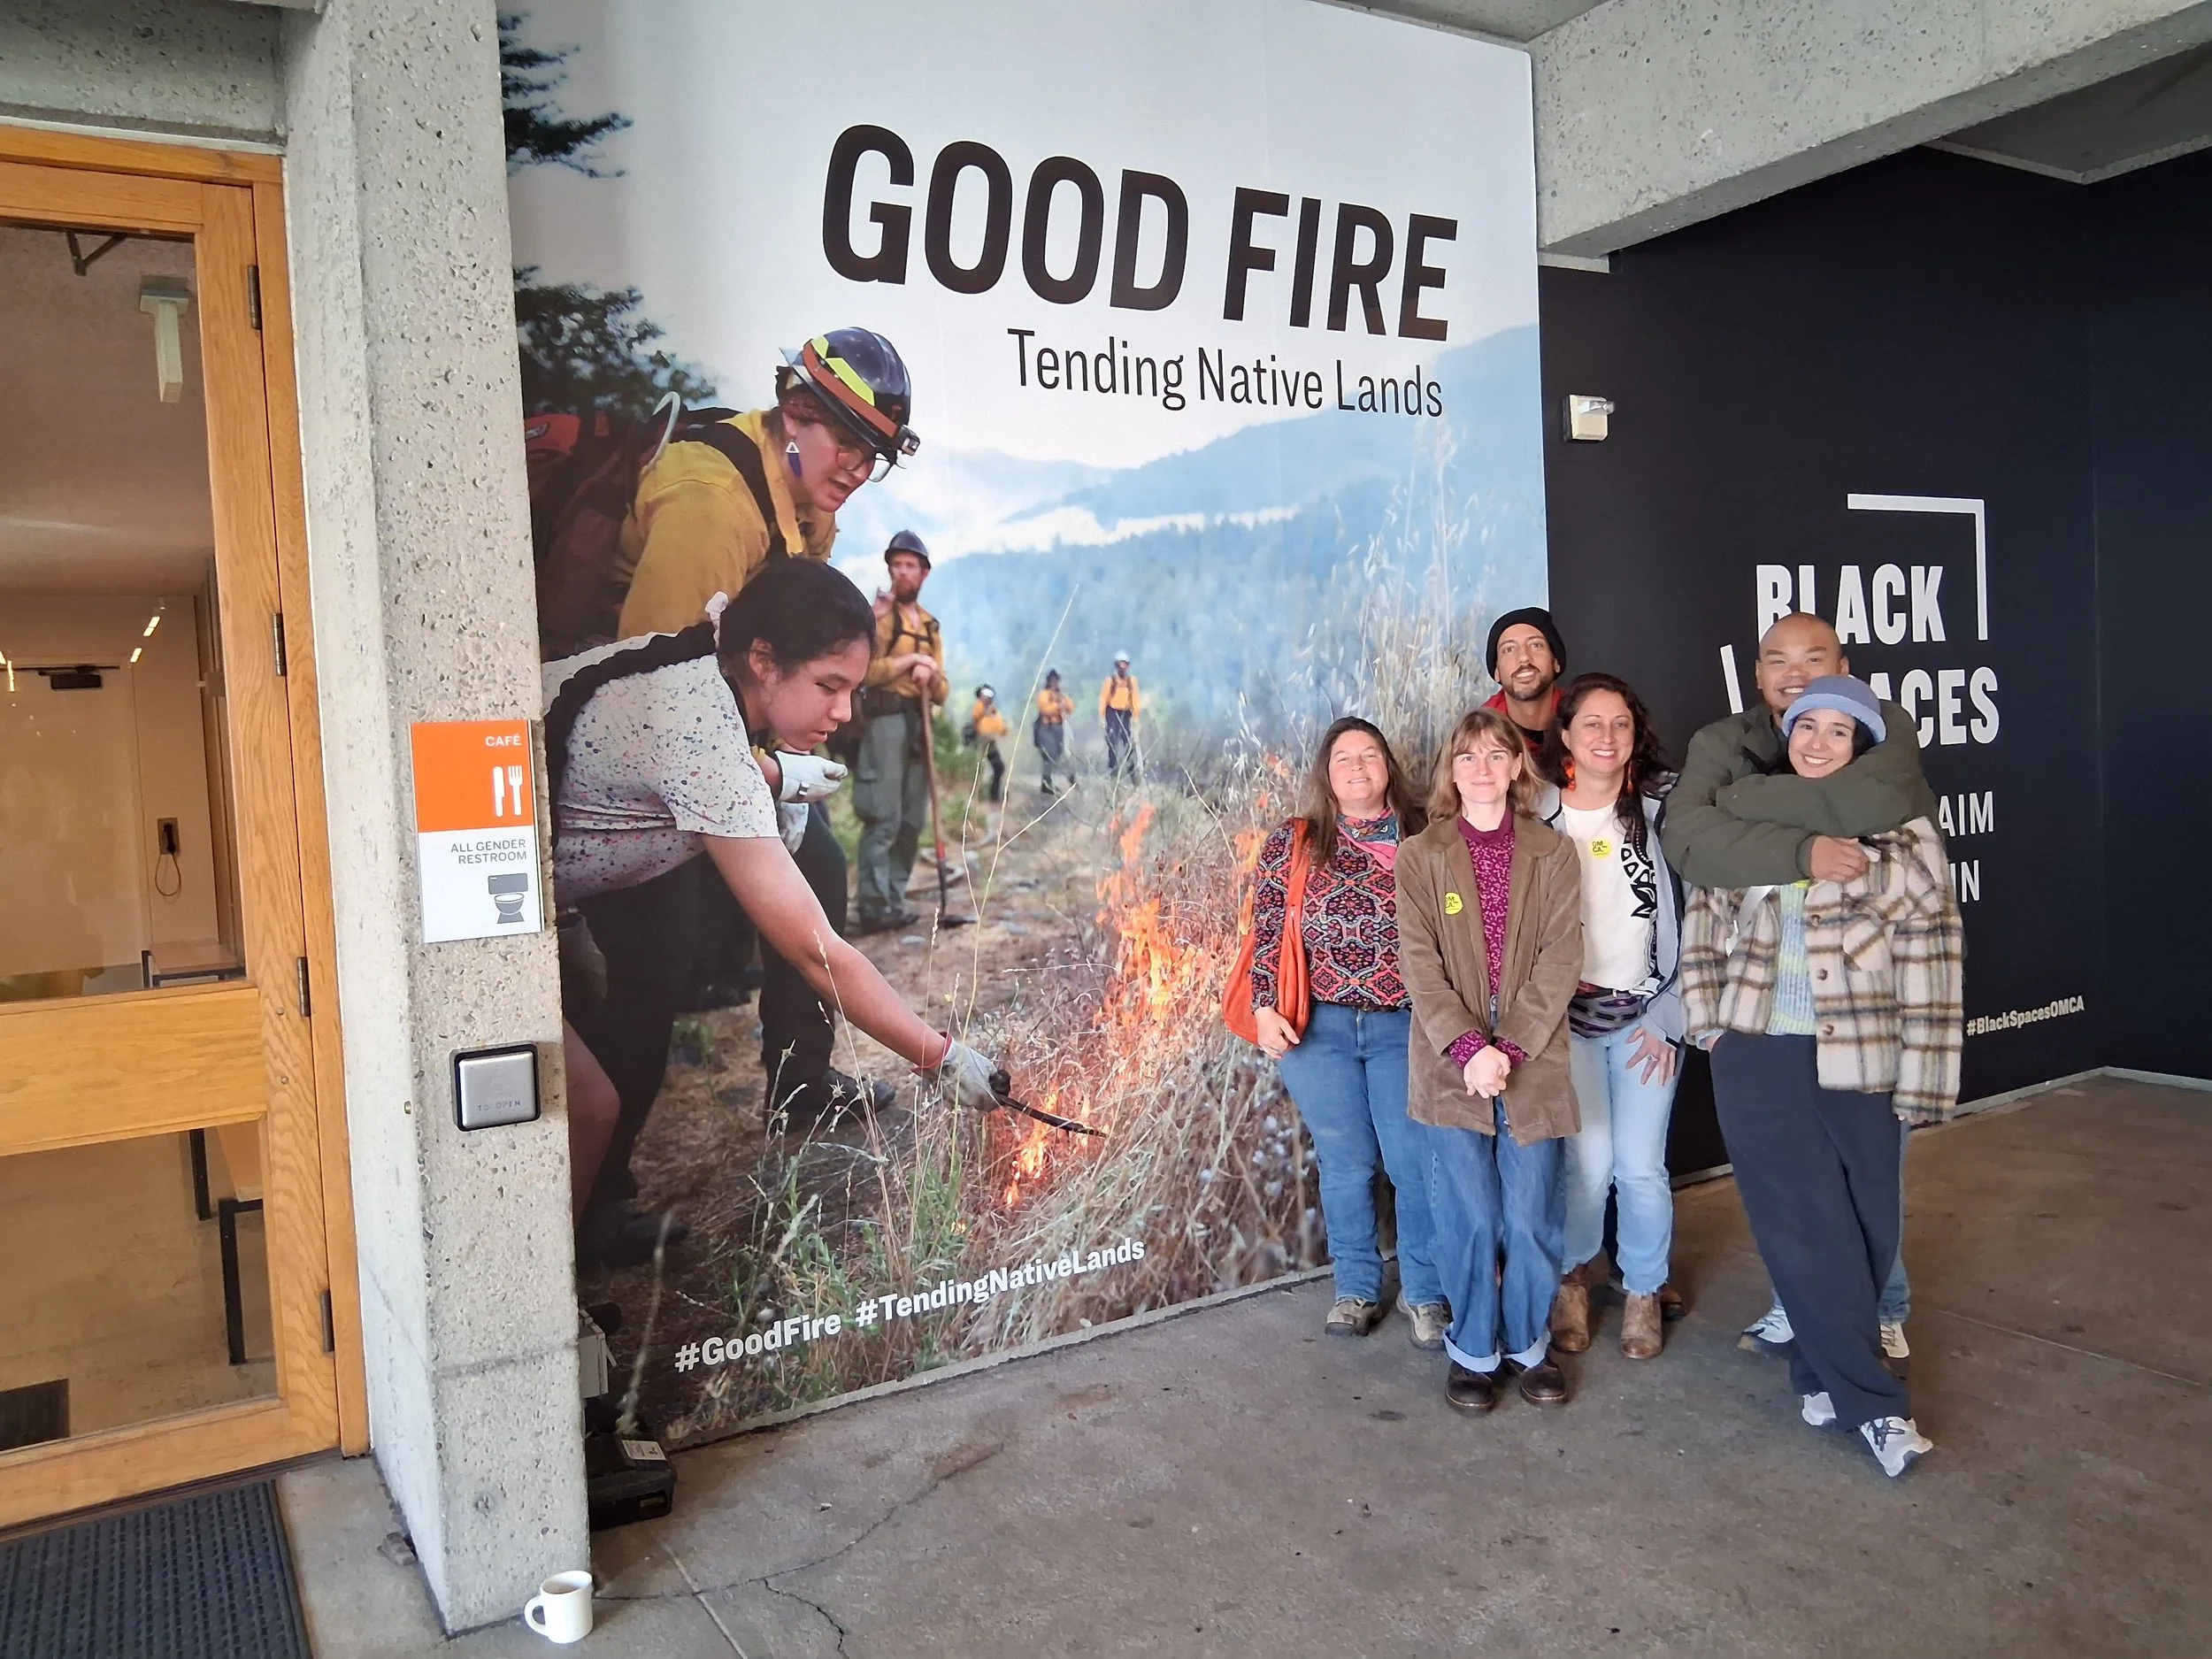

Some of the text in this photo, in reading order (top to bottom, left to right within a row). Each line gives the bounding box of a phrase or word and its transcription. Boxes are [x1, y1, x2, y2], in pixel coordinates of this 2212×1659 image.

[821, 124, 1458, 342] GOOD FIRE
[1007, 327, 1443, 417] Tending Native Lands
[485, 733, 522, 747] CAFÉ
[450, 840, 526, 853] ALL GENDER
[458, 850, 527, 864] RESTROOM
[1966, 995, 2085, 1037] #BlackSpacesOMCA
[495, 1100, 521, 1109] OPEN
[673, 1237, 1147, 1373] #GoodFire #TendingNativeLands
